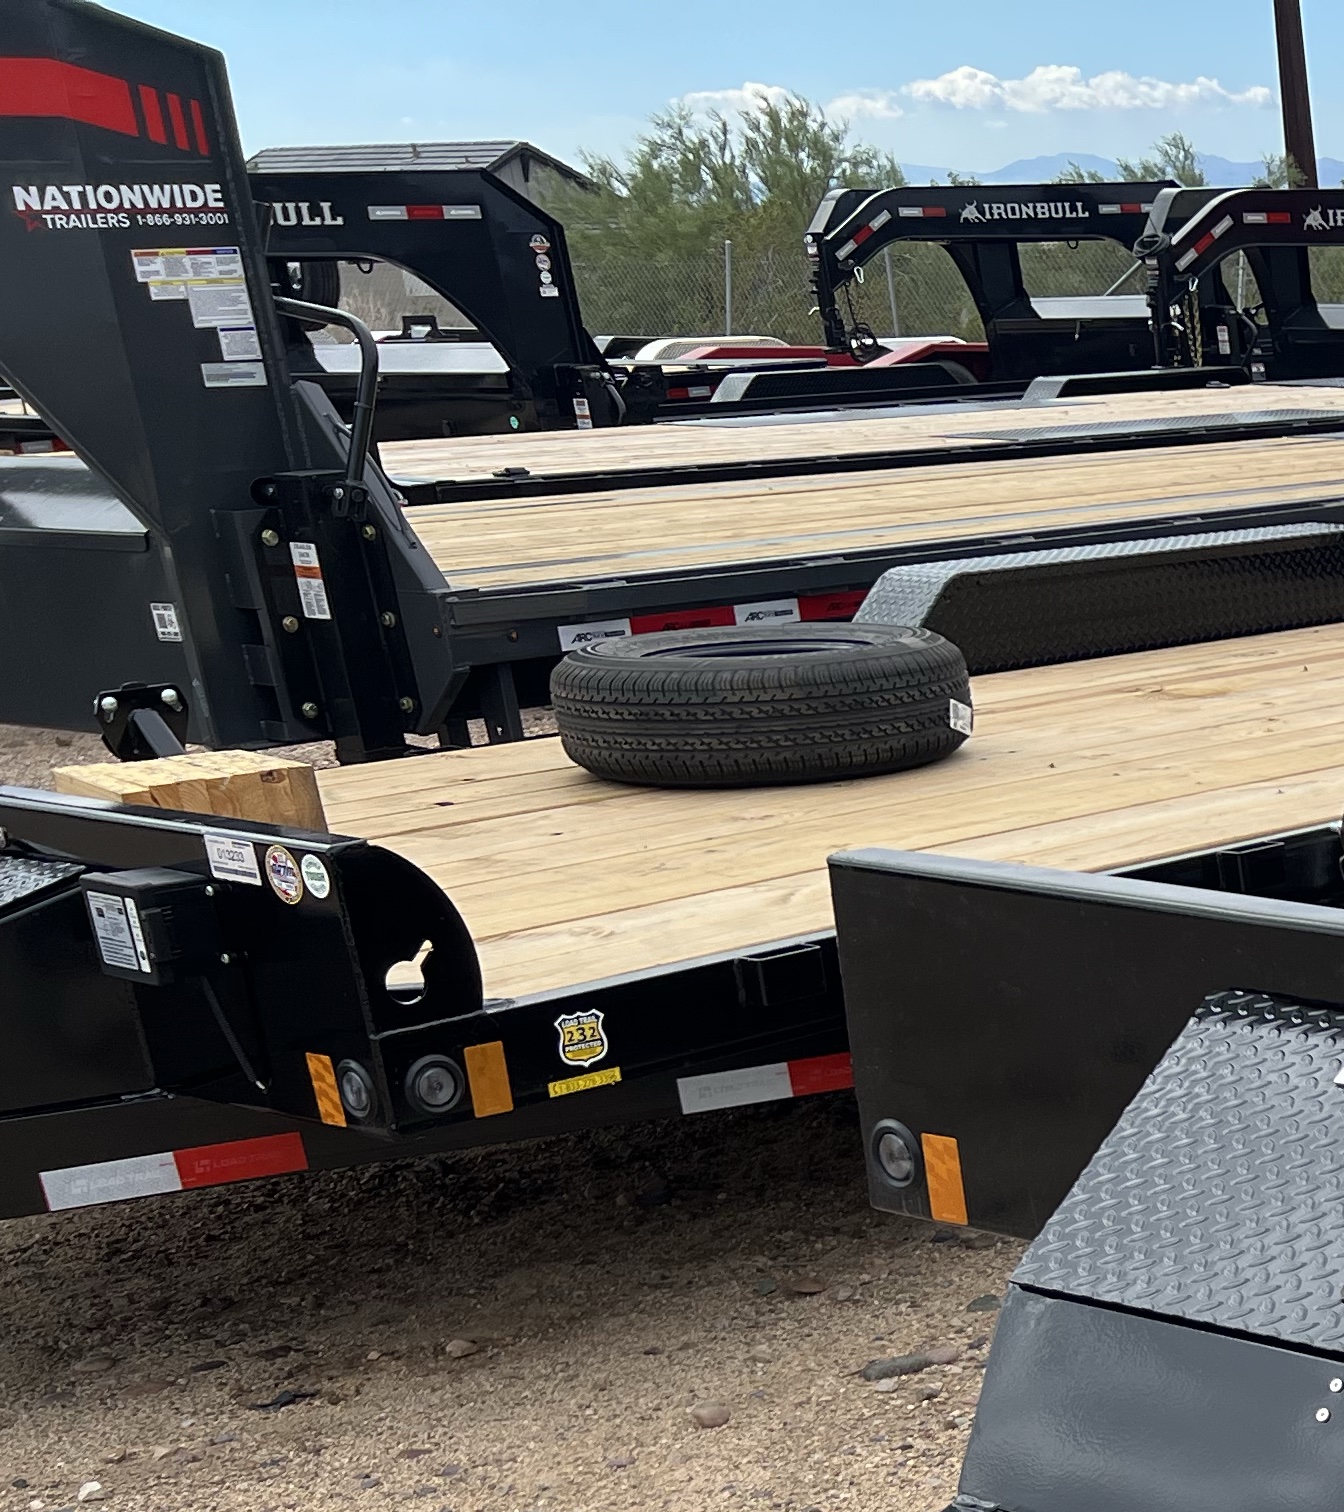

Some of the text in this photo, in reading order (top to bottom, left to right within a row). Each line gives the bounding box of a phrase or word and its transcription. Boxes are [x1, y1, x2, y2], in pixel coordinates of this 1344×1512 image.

[12, 184, 225, 211] NATIONWIDE
[983, 202, 1090, 219] IRONBULL
[42, 213, 229, 229] TRAILERS 1-866-931-3001
[561, 1018, 579, 1028] LOAD
[566, 1026, 598, 1042] 232
